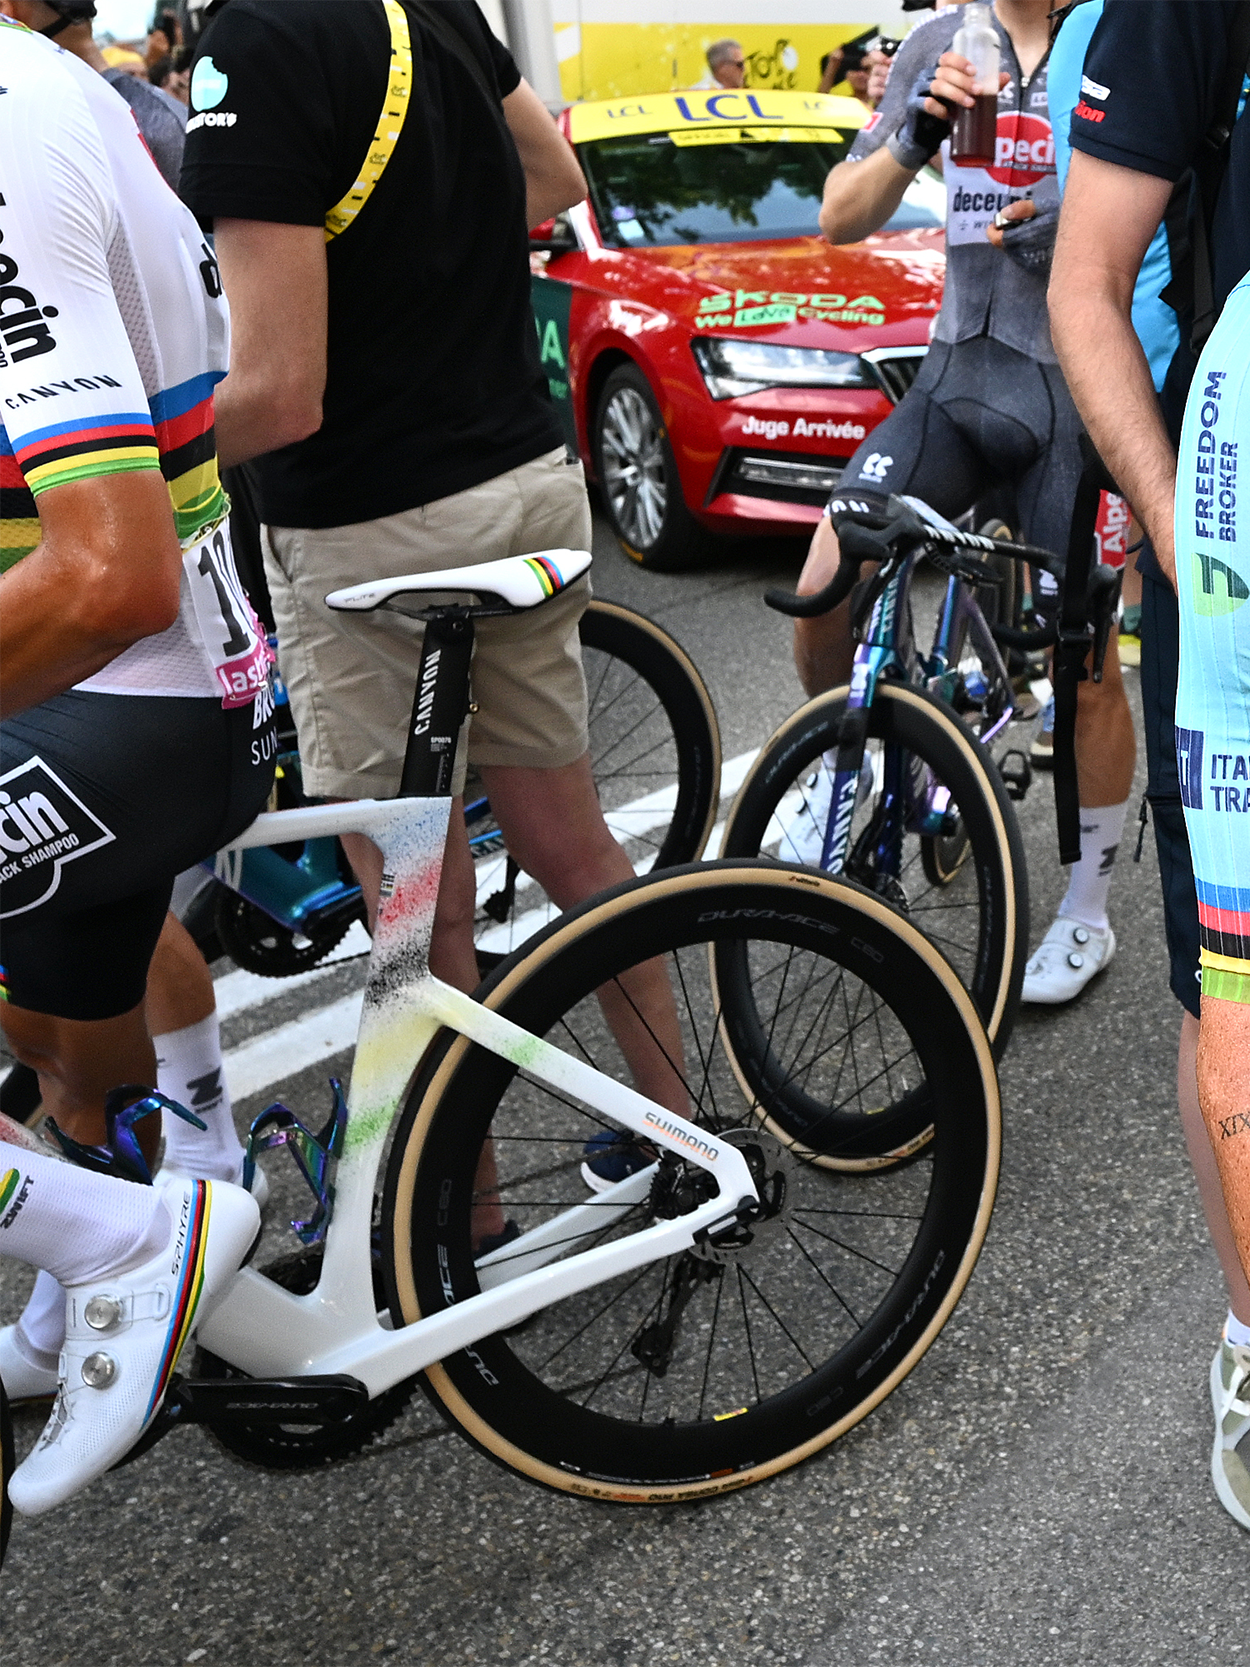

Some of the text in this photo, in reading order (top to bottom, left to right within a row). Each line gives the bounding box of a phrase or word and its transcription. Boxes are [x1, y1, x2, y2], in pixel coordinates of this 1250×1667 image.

[674, 94, 784, 122] LCL
[994, 132, 1056, 168] peci
[695, 313, 733, 329] We
[5, 374, 122, 409] CANYON
[742, 415, 866, 440] Juge Arrivée
[1195, 371, 1227, 539] FREEDOM
[1218, 442, 1239, 543] BROKER
[1103, 492, 1128, 553] Alpe
[414, 648, 442, 735] CANYON
[0, 832, 80, 884] ACK SHAMPOO
[643, 1112, 720, 1161] SHIMANO
